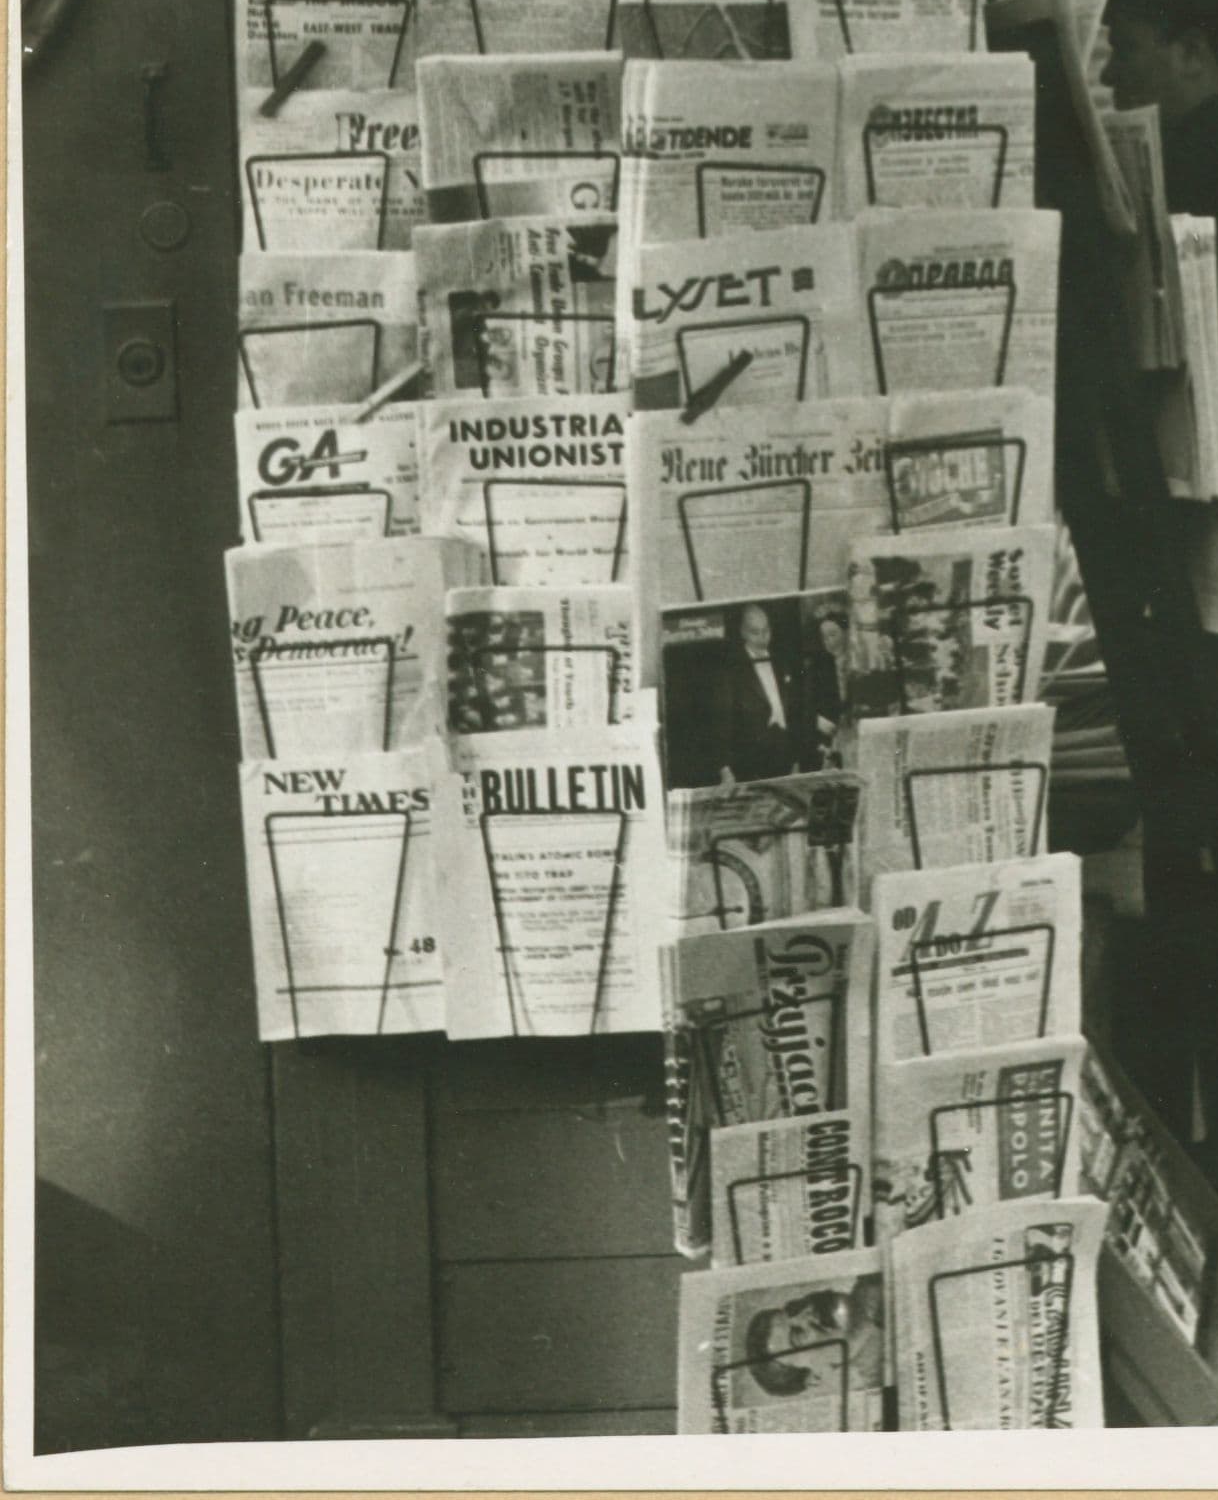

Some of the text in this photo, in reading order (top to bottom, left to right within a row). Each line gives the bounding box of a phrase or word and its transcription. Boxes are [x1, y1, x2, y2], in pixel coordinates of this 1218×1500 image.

[668, 125, 753, 149] TIDENDE
[282, 281, 385, 310] Freeman
[468, 441, 626, 471] UNIONIST
[660, 446, 728, 485] Neue
[274, 604, 376, 635] Peace,
[262, 768, 347, 796] NEW
[480, 763, 646, 815] BULLETIN
[315, 787, 432, 816] TIMES
[964, 889, 1003, 953] Z
[409, 936, 436, 956] 48
[1009, 1071, 1029, 1190] POPOLO
[991, 1248, 1009, 1330] GOVANI
